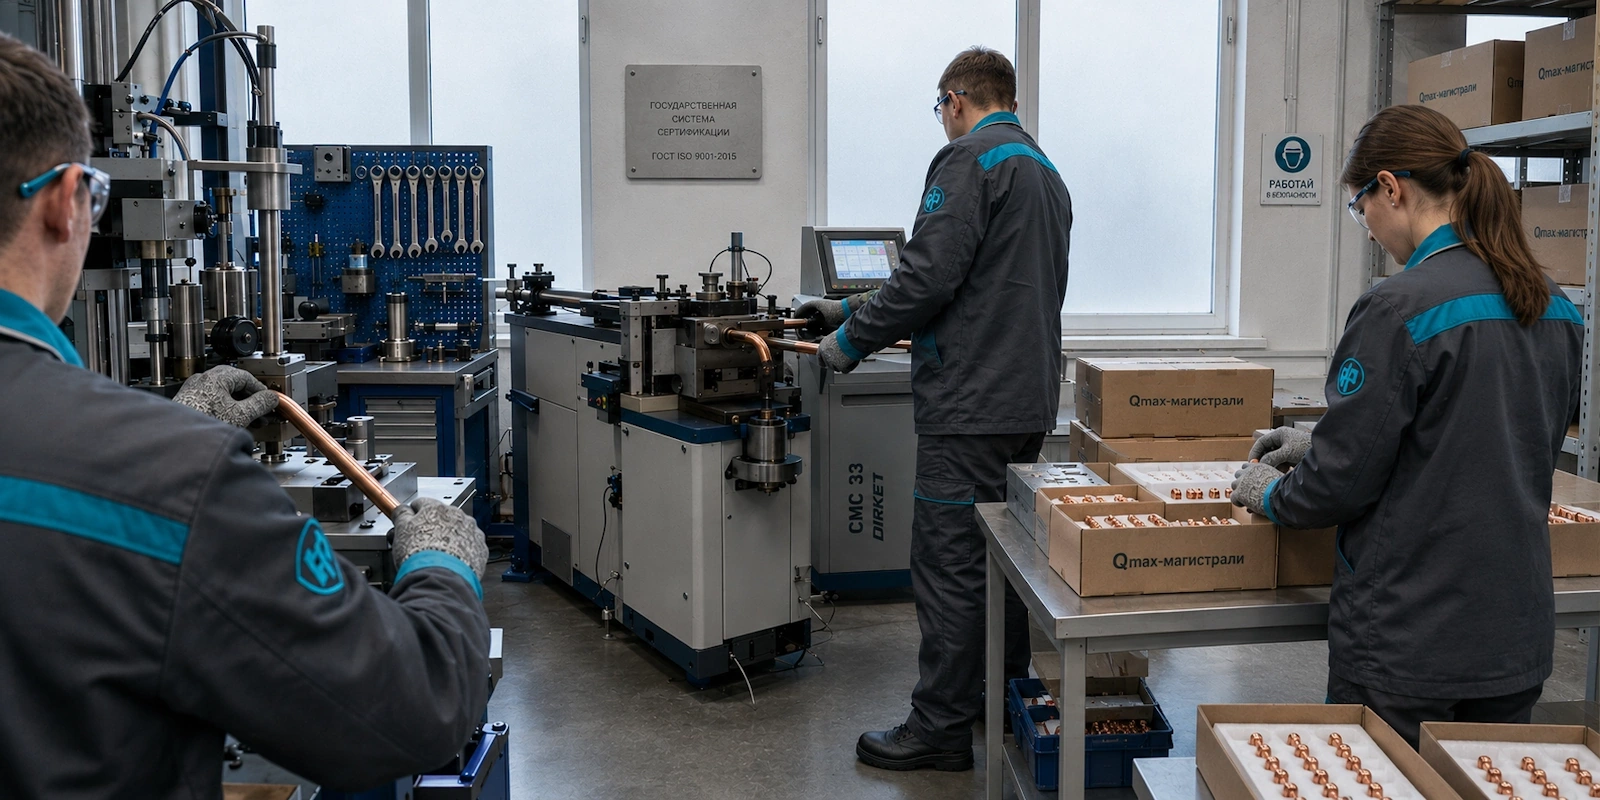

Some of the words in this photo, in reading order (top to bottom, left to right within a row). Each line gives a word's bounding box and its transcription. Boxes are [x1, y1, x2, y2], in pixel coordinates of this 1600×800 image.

[650, 101, 737, 110] ГОСУДАРСТВЕННАЯ
[671, 115, 716, 123] СИСТЕМА
[657, 128, 730, 137] СЕРТИФИКАЦИИ
[652, 152, 675, 160] ГОСТ
[677, 152, 693, 160] ISO
[694, 152, 737, 160] 9001-2015
[1269, 178, 1314, 189] РАБОТАЙ
[1129, 394, 1244, 408] Qmax-магистрали
[848, 463, 864, 485] 33
[872, 472, 884, 542] DIRKET
[848, 493, 864, 534] CMC
[1112, 552, 1245, 570] Qmax-магистрали
